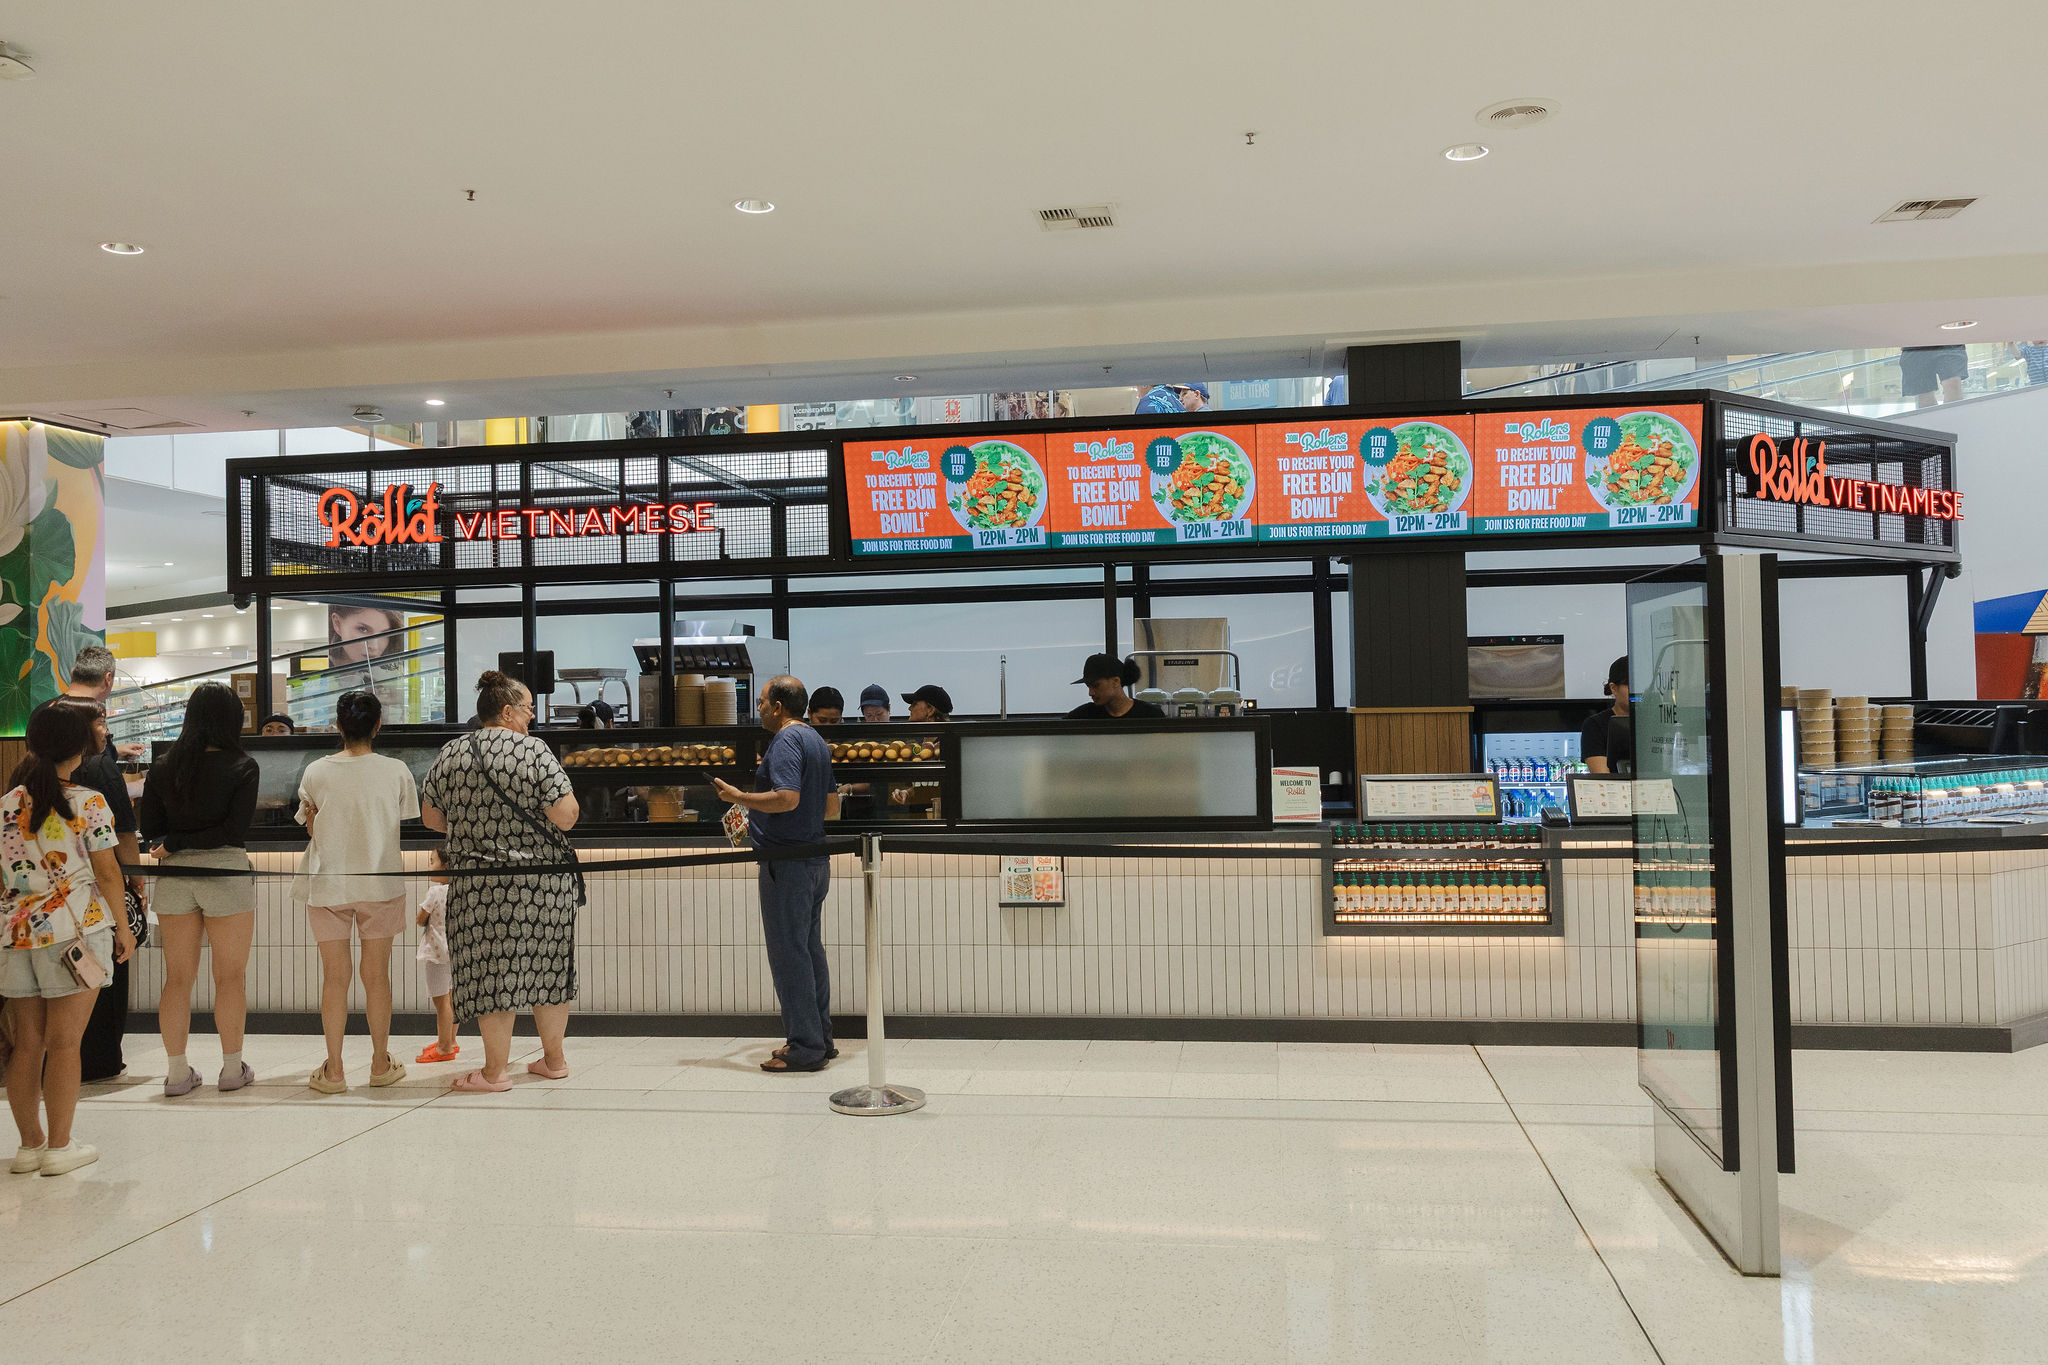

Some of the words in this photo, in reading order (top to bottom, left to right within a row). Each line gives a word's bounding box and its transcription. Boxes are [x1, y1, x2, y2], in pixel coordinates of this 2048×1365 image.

[1230, 385, 1246, 400] SALE
[1248, 383, 1270, 398] ITEMS
[1521, 418, 1569, 442] Rollers
[1593, 425, 1611, 437] 11TH
[1301, 429, 1347, 451] Rollers
[1370, 435, 1387, 447] 11TH
[1594, 437, 1607, 449] FEB
[1089, 438, 1133, 460] Rollers
[1155, 445, 1171, 456] 11TH
[1371, 447, 1384, 458] FEB
[1496, 449, 1508, 462] TO
[1510, 447, 1548, 461] RECEIVE
[1550, 446, 1576, 460] YOUR
[886, 447, 929, 469] Rollers
[950, 453, 965, 465] 11TH
[1156, 456, 1169, 467] FEB
[1277, 458, 1290, 471] TO
[1292, 456, 1328, 471] RECEIVE
[1329, 455, 1354, 469] YOUR
[951, 465, 964, 475] FEB
[1067, 467, 1079, 480] TO
[1081, 465, 1115, 479] RECEIVE
[1117, 464, 1141, 478] YOUR
[1500, 464, 1536, 487] FREE
[1539, 460, 1573, 485] BÚN
[865, 475, 877, 488] TO
[879, 473, 912, 487] RECEIVE
[913, 472, 937, 486] YOUR
[1283, 473, 1317, 495] FREE
[1320, 468, 1352, 494] BÚN
[871, 490, 904, 511] FREE
[906, 484, 936, 510] BÚN
[1073, 482, 1106, 504] FREE
[1109, 476, 1140, 502] BÚN
[1829, 477, 1965, 520] VIETNAMESE
[457, 502, 717, 540] VIETNAMESE
[1617, 506, 1647, 524] 12PM
[1658, 504, 1684, 522] 2PM
[1183, 522, 1211, 539] 12PM
[1221, 520, 1245, 537] 2PM
[1270, 527, 1286, 538] JOIN
[1287, 527, 1297, 537] US
[1299, 526, 1313, 537] FOR
[1314, 526, 1330, 537] FREE
[1332, 525, 1351, 536] FOOD
[1353, 524, 1366, 535] DAY
[1395, 515, 1425, 532] 12PM
[1435, 514, 1460, 530] 2PM
[1485, 520, 1502, 530] JOIN
[1503, 519, 1514, 530] US
[1515, 519, 1530, 529] FOR
[1531, 518, 1548, 529] FREE
[1550, 517, 1570, 528] FOOD
[1572, 516, 1586, 527] DAY
[862, 541, 878, 552] JOIN
[878, 541, 889, 551] US
[890, 540, 903, 550] FOR
[904, 539, 920, 550] FREE
[920, 538, 939, 550] FOOD
[940, 538, 953, 549] DAY
[979, 529, 1007, 546] 12PM
[1015, 528, 1039, 544] 2PM
[1062, 534, 1078, 545] JOIN
[1079, 534, 1089, 545] US
[1090, 533, 1103, 544] FOR
[1104, 533, 1121, 544] FREE
[1122, 532, 1141, 543] FOOD
[1142, 531, 1155, 543] DAY
[1656, 670, 1679, 696] QUIET
[1659, 704, 1677, 723] TIME
